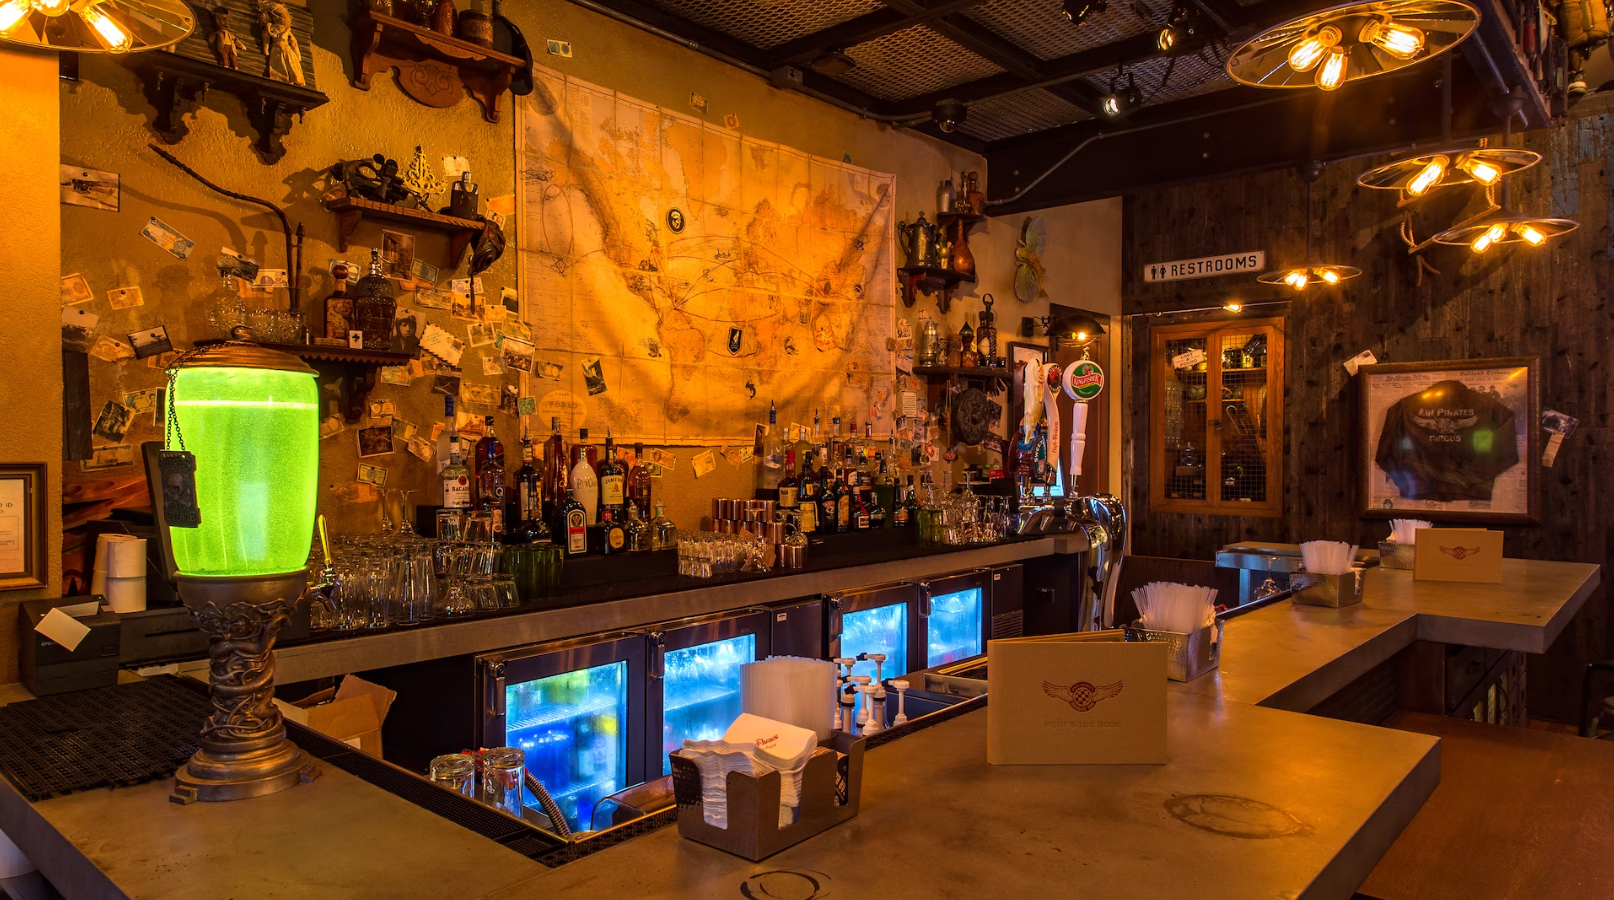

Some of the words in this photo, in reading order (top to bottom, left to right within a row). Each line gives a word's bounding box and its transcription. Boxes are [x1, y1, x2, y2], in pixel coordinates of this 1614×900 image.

[1171, 255, 1257, 276] RESTROOMS
[1180, 359, 1197, 367] FOUND
[1073, 374, 1100, 387] KINGFISHER
[1418, 408, 1435, 416] AIR
[1437, 408, 1475, 417] PIRATES
[1429, 434, 1461, 442] CIRCUS
